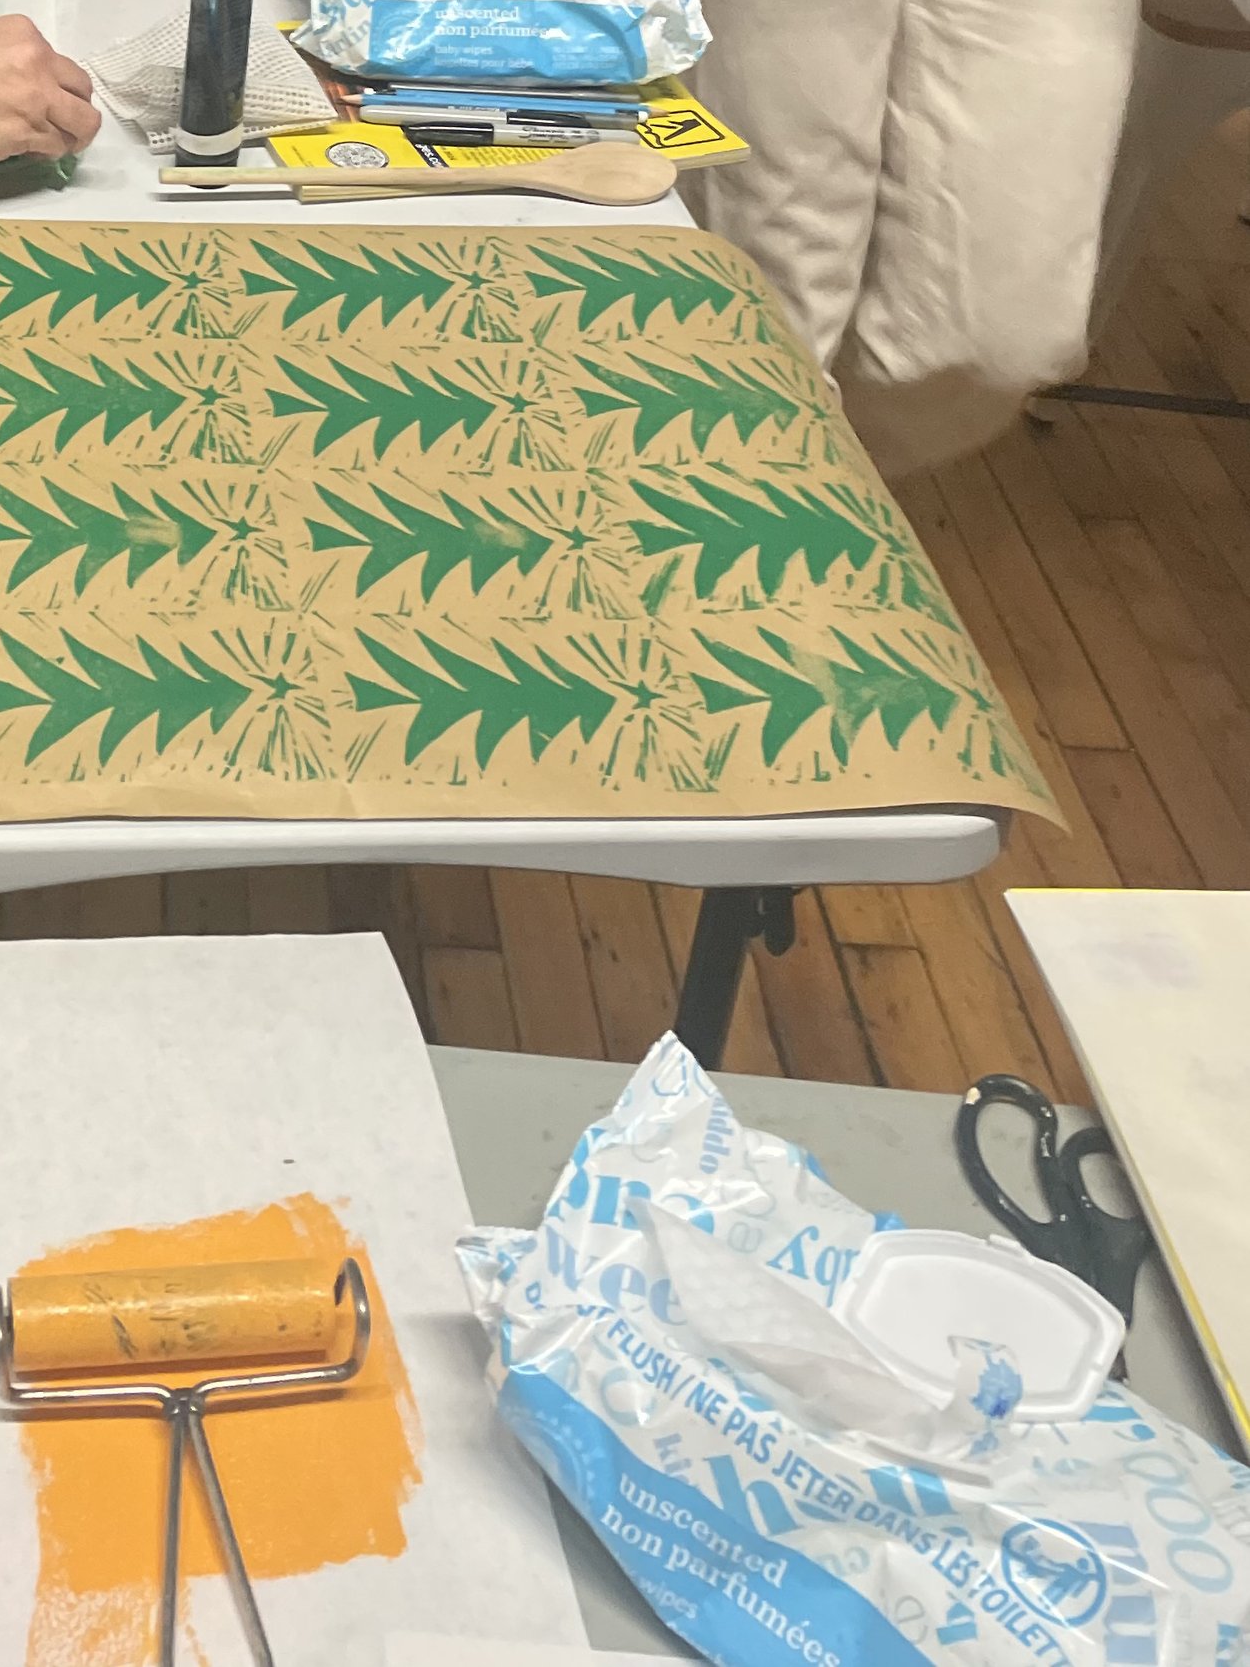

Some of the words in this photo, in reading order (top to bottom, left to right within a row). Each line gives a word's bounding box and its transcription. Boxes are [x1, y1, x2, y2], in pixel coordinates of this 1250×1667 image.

[435, 25, 467, 37] non
[606, 1318, 682, 1394] FLUSH
[685, 1381, 728, 1426] NE
[723, 1407, 777, 1466] PAS
[772, 1449, 856, 1514] JETER
[854, 1500, 937, 1554] DANS
[932, 1538, 980, 1589] LES
[600, 1503, 662, 1559] non
[664, 1542, 842, 1667] parfumées
[619, 1472, 788, 1589] unscented
